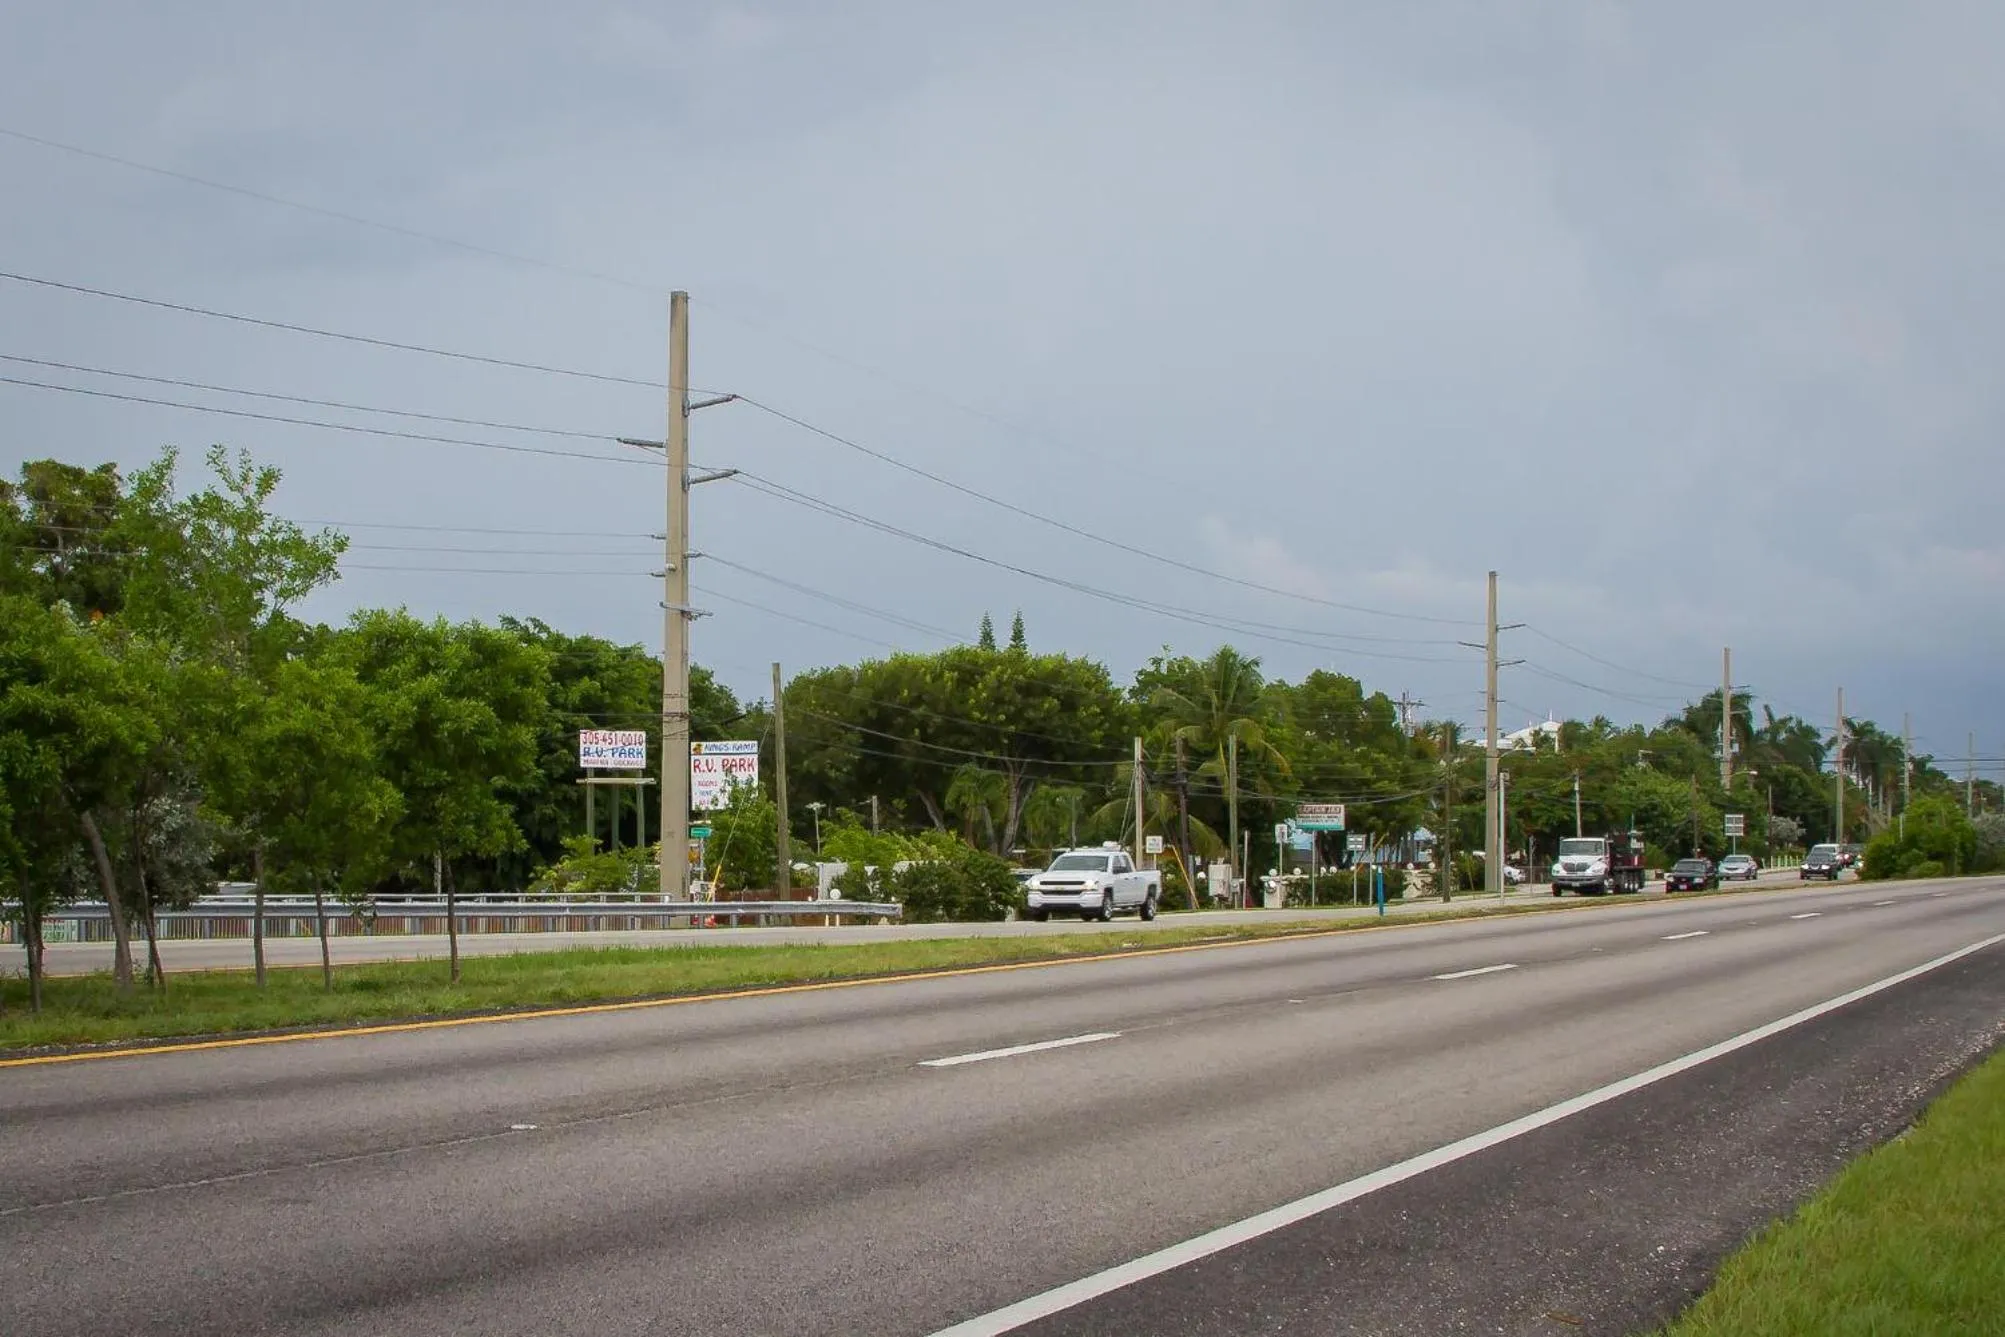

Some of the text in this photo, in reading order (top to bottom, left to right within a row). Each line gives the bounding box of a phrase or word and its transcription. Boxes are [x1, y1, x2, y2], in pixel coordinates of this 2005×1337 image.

[582, 731, 644, 746] 305-451-0010
[583, 746, 644, 759] R.V. PARK
[693, 757, 755, 773] R.V. PARK
